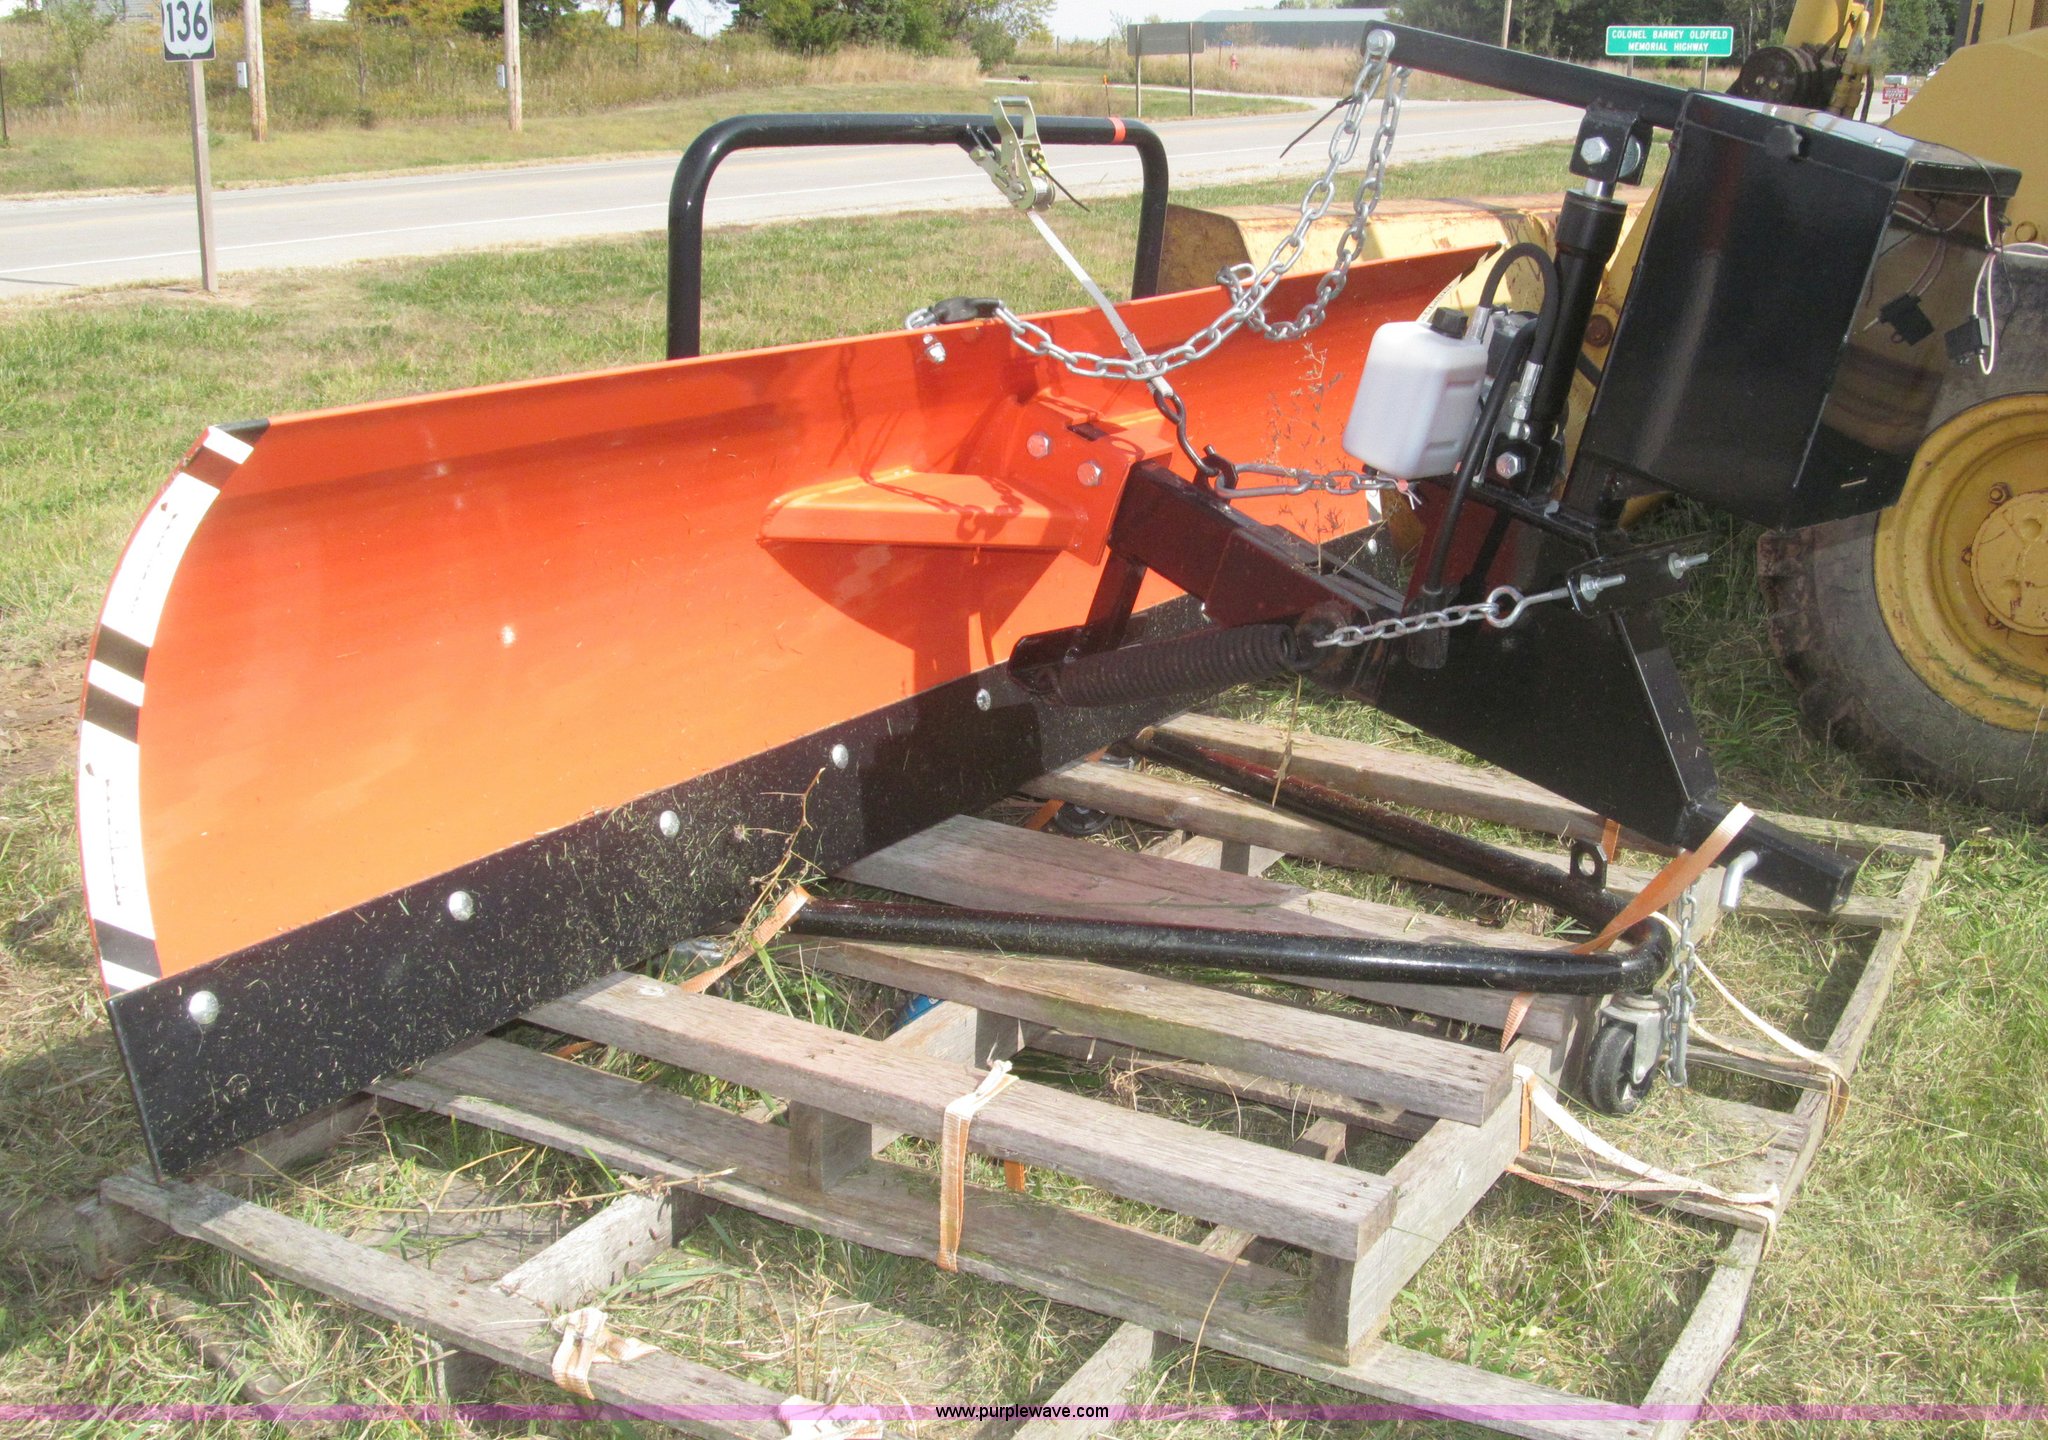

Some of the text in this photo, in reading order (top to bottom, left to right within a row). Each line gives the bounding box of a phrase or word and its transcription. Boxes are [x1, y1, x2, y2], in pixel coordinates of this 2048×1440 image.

[166, 1, 208, 42] 136
[1611, 30, 1728, 40] COLONEL BARNEY OLDFIELD
[1628, 42, 1709, 52] MEMORIAL HIGHWAY
